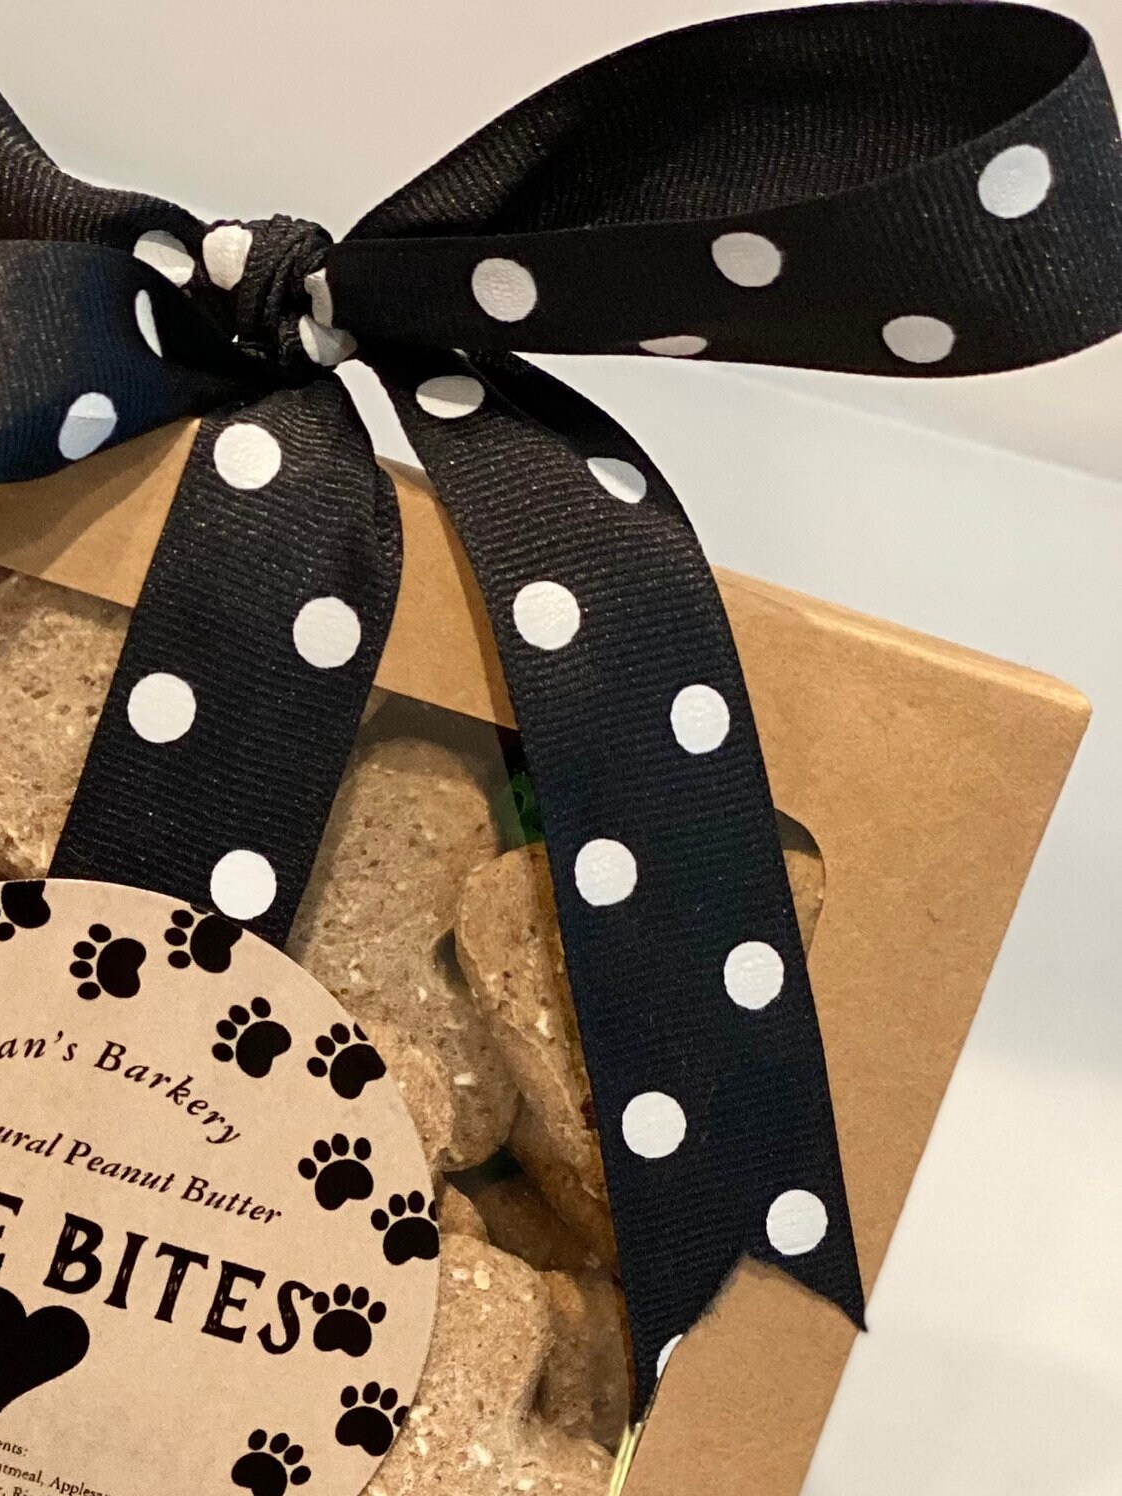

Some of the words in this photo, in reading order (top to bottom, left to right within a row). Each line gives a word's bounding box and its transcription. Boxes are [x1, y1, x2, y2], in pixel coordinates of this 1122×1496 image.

[94, 1040, 241, 1145] Barkery
[63, 1139, 175, 1193] Peanut
[180, 1175, 282, 1224] Butter
[43, 1212, 314, 1355] BITES
